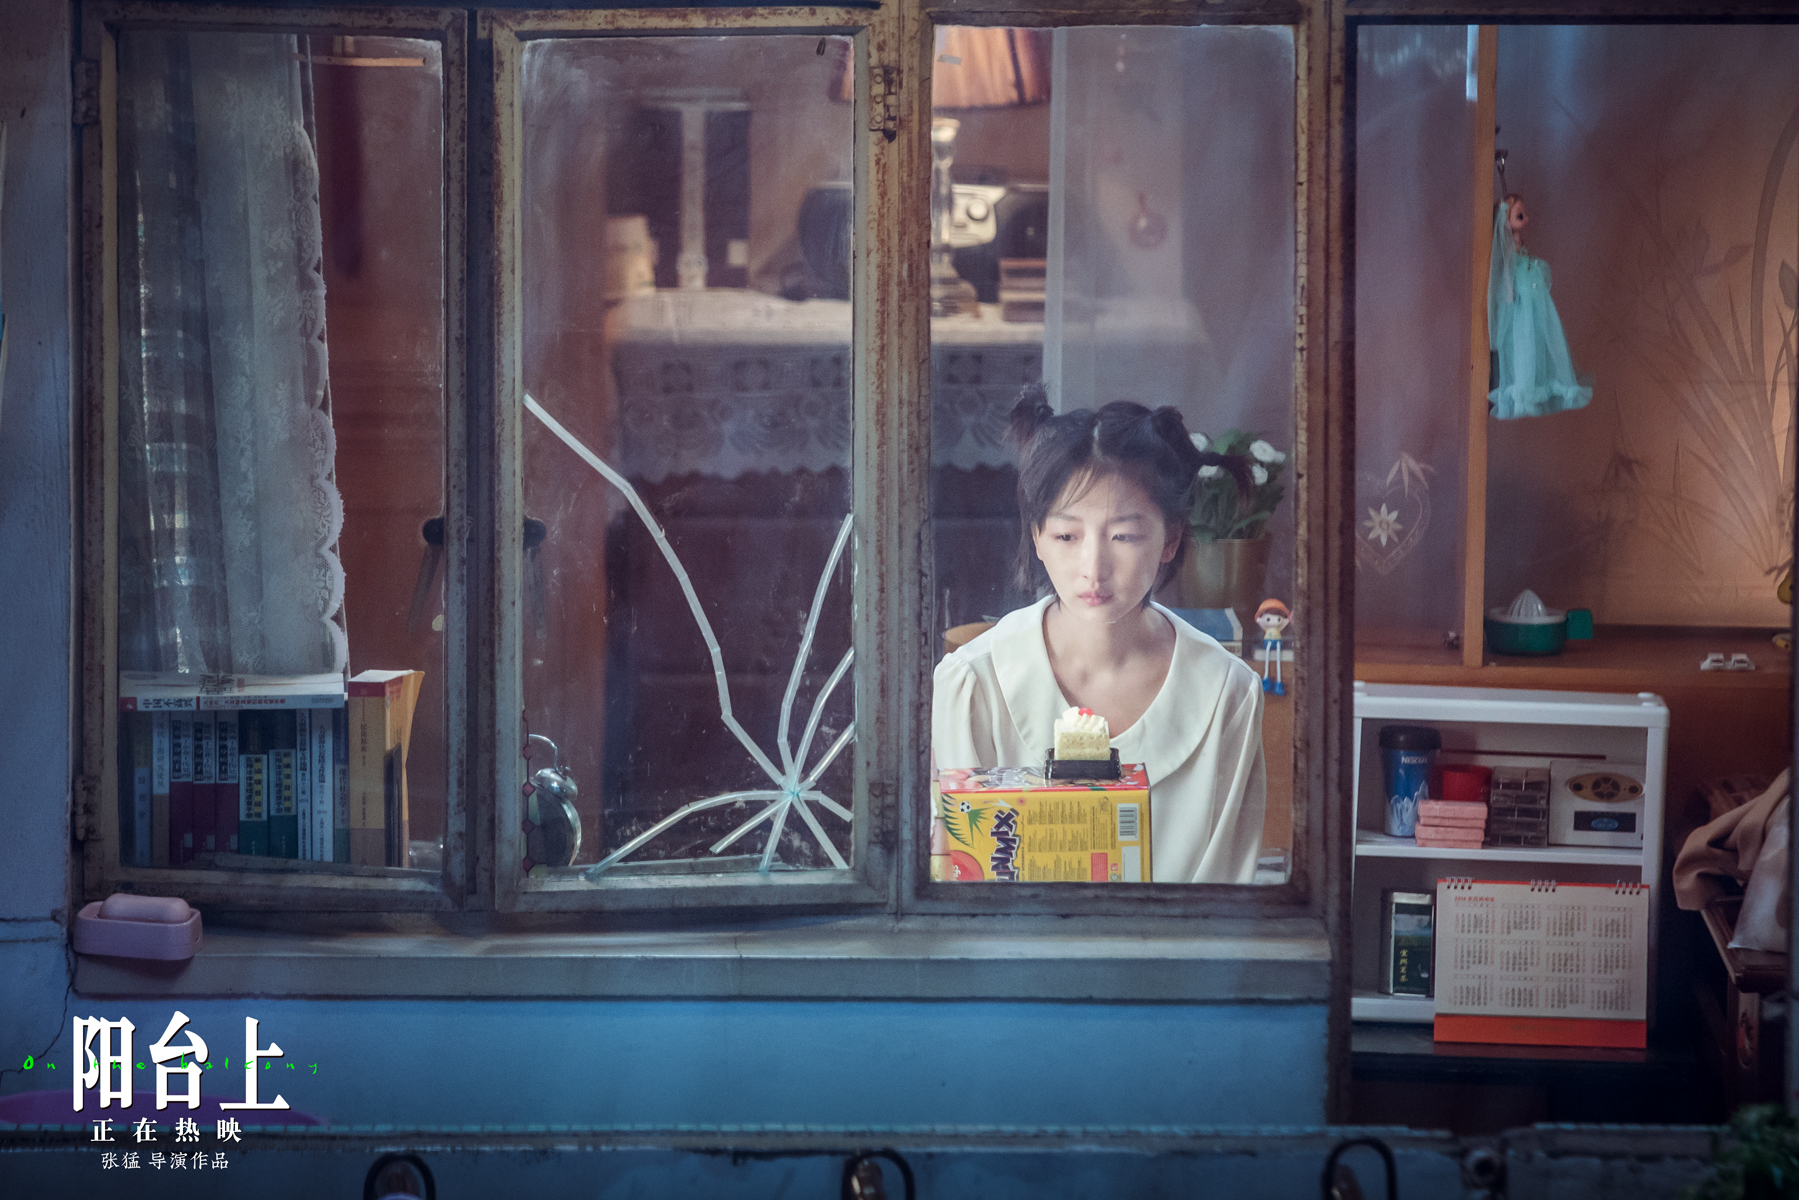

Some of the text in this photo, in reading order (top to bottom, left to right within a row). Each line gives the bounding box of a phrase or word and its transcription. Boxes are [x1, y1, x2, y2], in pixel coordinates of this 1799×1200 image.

[142, 698, 193, 709] 中国不高兴
